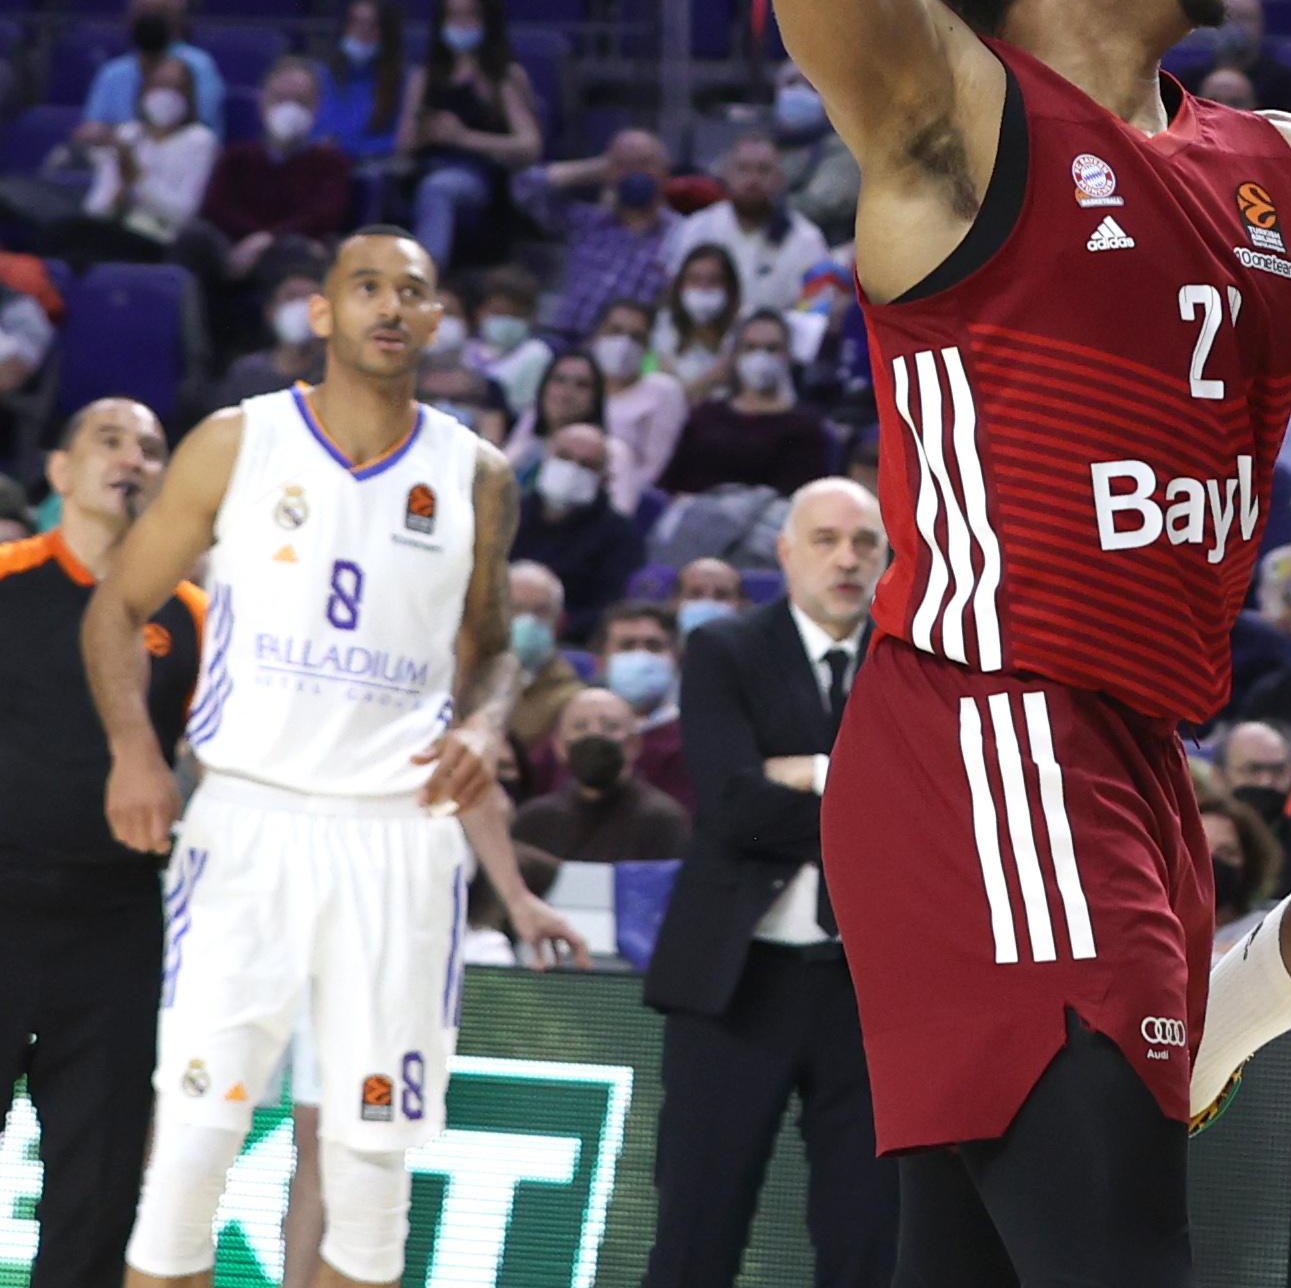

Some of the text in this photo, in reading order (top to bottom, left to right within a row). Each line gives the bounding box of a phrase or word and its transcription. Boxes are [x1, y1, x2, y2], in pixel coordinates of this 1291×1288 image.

[1087, 237, 1135, 252] adidas
[1178, 285, 1242, 399] 2
[327, 560, 362, 630] 8
[402, 1050, 424, 1120] 8
[1147, 1048, 1169, 1060] Audi
